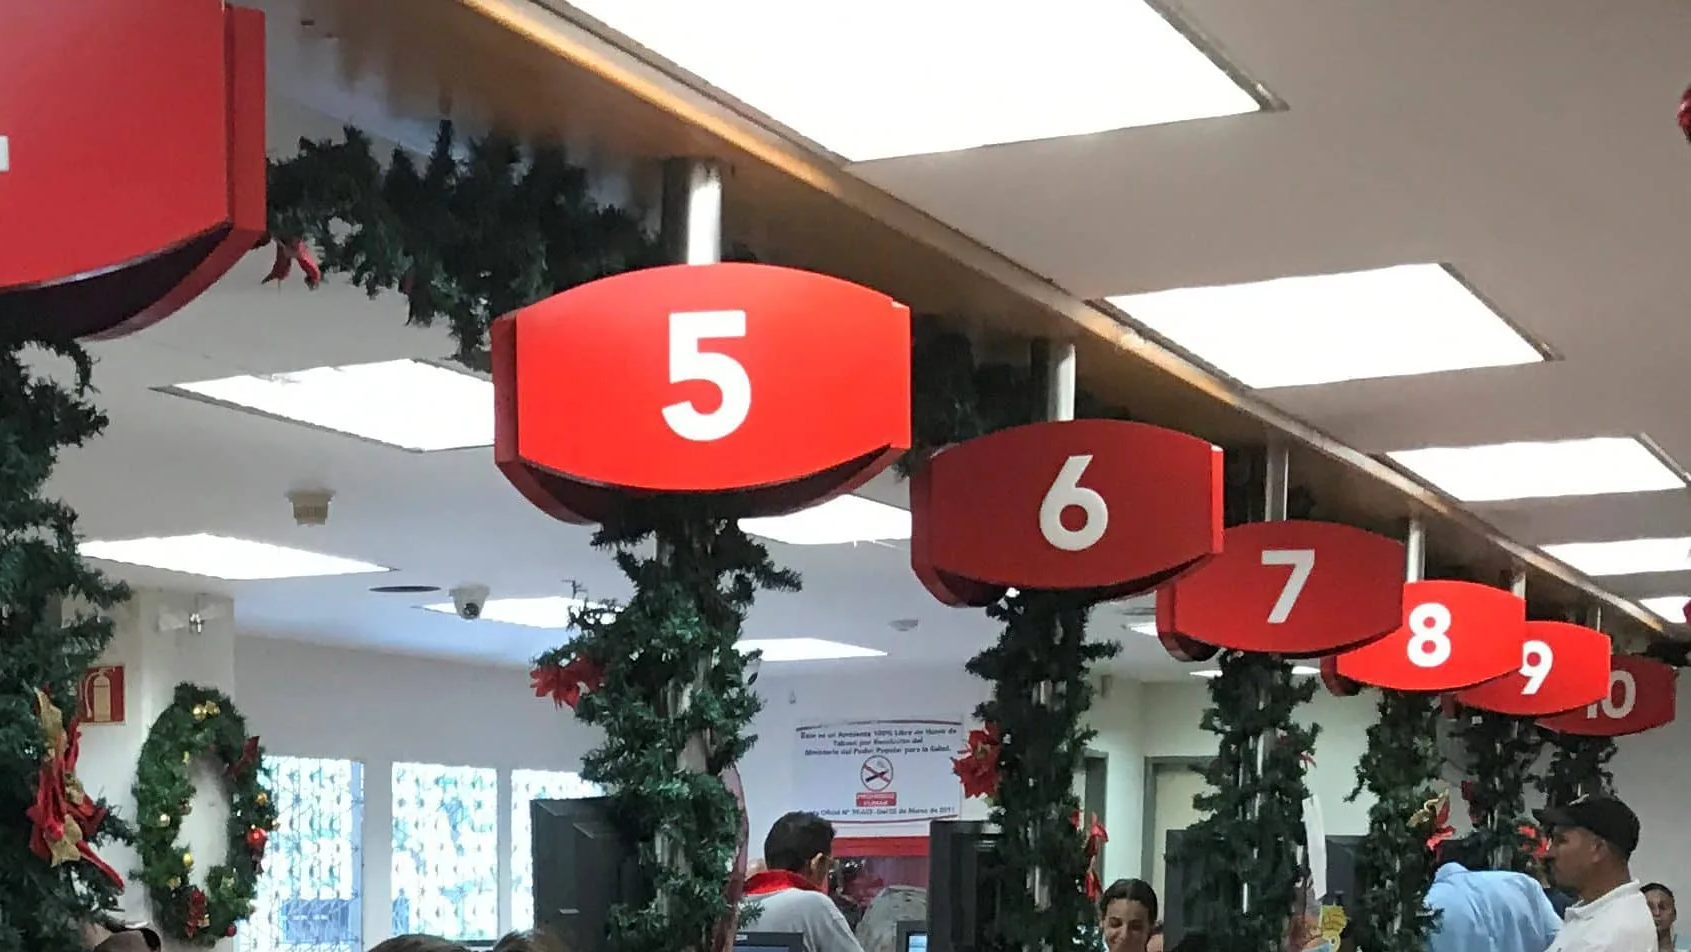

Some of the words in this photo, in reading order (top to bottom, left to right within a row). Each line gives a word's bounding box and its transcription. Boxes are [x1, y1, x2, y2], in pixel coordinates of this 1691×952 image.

[662, 310, 752, 442] 5
[1039, 455, 1109, 551] 6
[1261, 549, 1315, 624] 7
[1407, 602, 1452, 668] 8
[1518, 640, 1554, 695] 9
